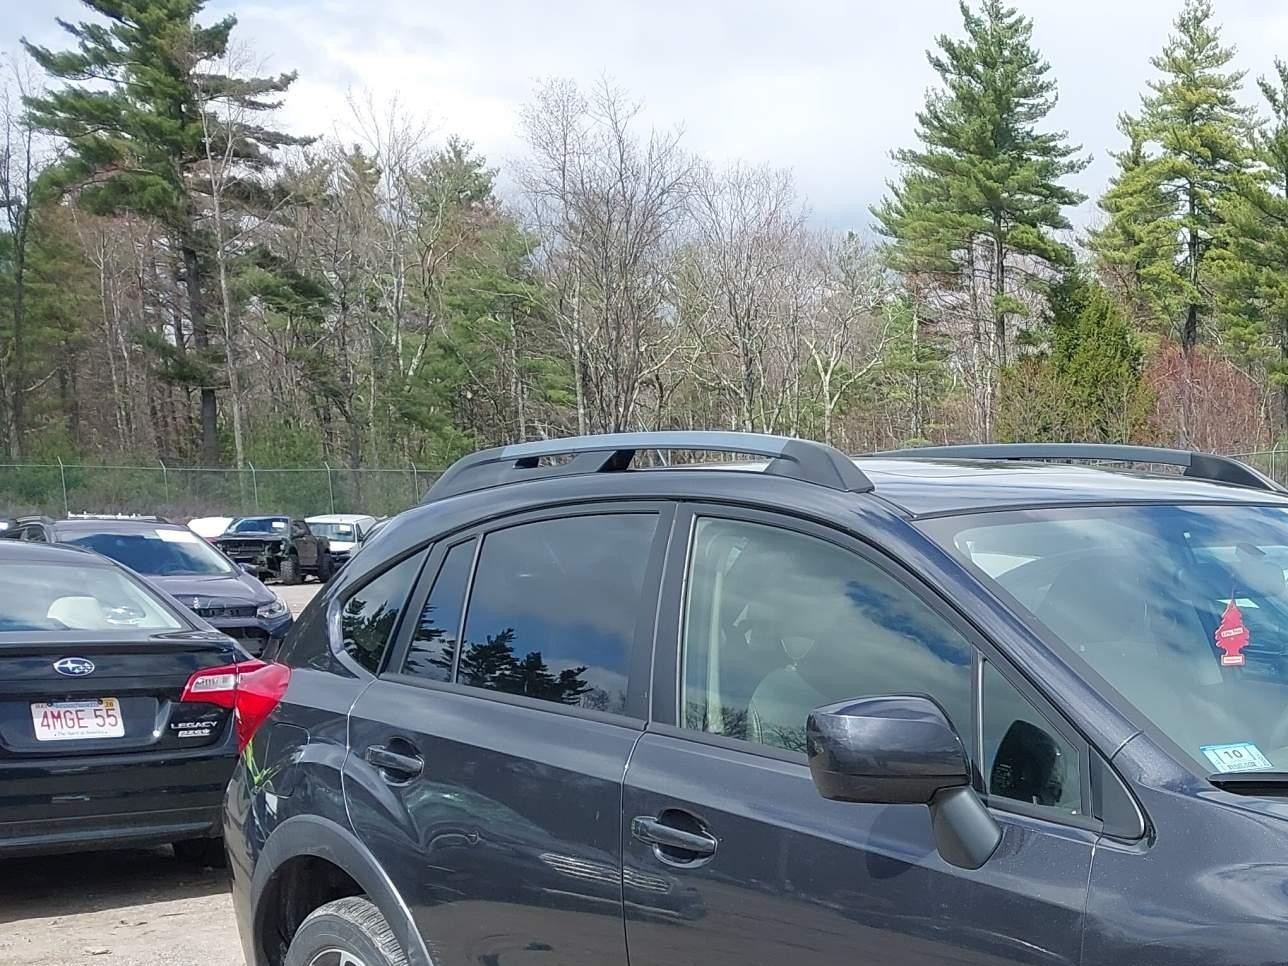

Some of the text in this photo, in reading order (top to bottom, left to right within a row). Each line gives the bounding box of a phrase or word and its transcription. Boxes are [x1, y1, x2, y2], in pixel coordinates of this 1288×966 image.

[41, 708, 118, 731] 4MGE 55
[171, 721, 218, 729] LEGACY
[1224, 749, 1243, 759] 10
